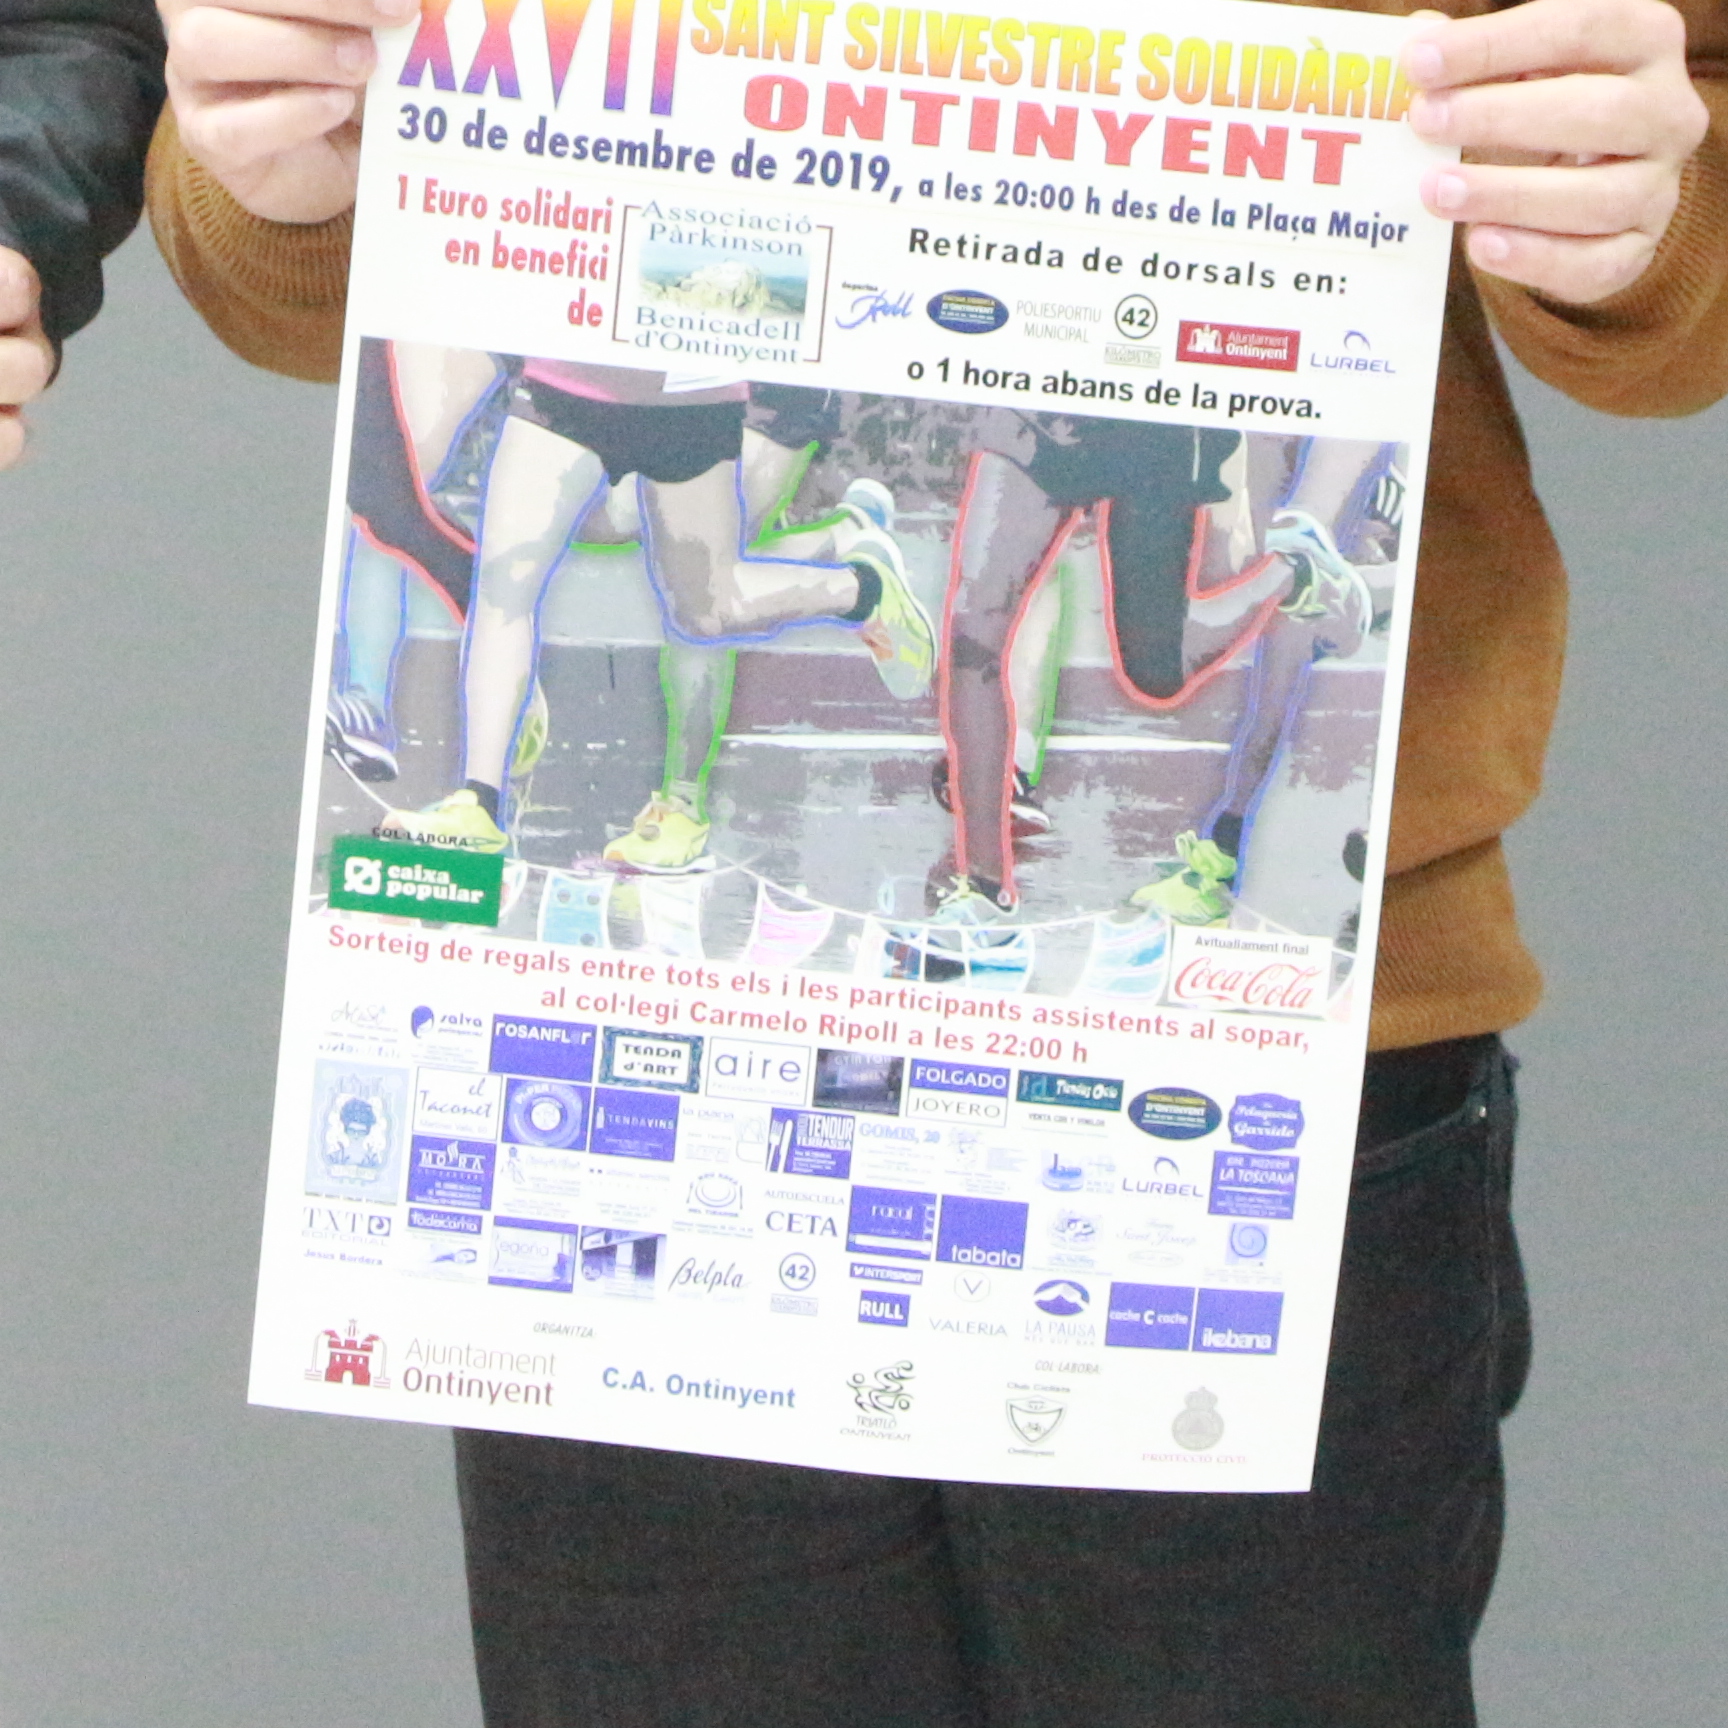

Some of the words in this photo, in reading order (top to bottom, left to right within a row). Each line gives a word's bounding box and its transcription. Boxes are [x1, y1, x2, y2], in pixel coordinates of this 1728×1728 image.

[843, 2, 1126, 96] SILVESTRE
[743, 74, 1361, 186] ONTINYENT
[397, 103, 447, 143] 30
[462, 107, 508, 151] de
[523, 115, 715, 174] desembre
[730, 137, 777, 180] de
[793, 147, 902, 203] 2019,
[918, 179, 934, 198] a
[944, 171, 982, 202] les
[993, 179, 1074, 211] 20:00
[1084, 185, 1100, 215] h
[1111, 189, 1157, 220] des
[1168, 194, 1200, 224] de
[1211, 198, 1236, 228] la
[1246, 202, 1316, 240] Plaça
[1327, 210, 1408, 248] Major
[397, 174, 408, 210] 1
[422, 177, 487, 219] Euro
[499, 187, 613, 234] solidari
[641, 200, 812, 234] Associació
[444, 238, 480, 266] en
[491, 229, 609, 281] benefici
[908, 227, 1063, 268] Retirada
[1082, 246, 1122, 274] de
[1140, 252, 1274, 288] dorsals
[1293, 272, 1346, 294] en:
[567, 287, 603, 327] de
[636, 306, 802, 341] Benicadell
[1121, 307, 1150, 327] 42
[1309, 352, 1395, 373] LURBEL
[906, 361, 924, 380] o
[937, 357, 949, 382] 1
[962, 359, 1030, 391] hora
[1041, 369, 1133, 401] abans
[1144, 379, 1181, 406] de
[1191, 382, 1217, 409] la
[1227, 393, 1320, 418] prova.
[385, 874, 484, 903] popular
[386, 863, 453, 884] caixa
[328, 924, 429, 963] Sorteig
[440, 938, 472, 962] de
[483, 949, 569, 975] regals
[581, 959, 654, 982] entre
[666, 964, 719, 989] tots
[730, 971, 770, 994] els
[781, 974, 787, 996] i
[799, 976, 838, 1001] les
[849, 987, 1021, 1021] participants
[1032, 1006, 1178, 1036] assistents
[1190, 1018, 1214, 1039] al
[1225, 1025, 1308, 1052] sopar,
[540, 986, 565, 1008] al
[689, 1000, 807, 1033] Carmelo
[818, 1013, 897, 1044] Ripoll
[908, 1029, 923, 1045] a
[934, 1026, 973, 1051] les
[985, 1032, 1061, 1060] 22:00
[1072, 1040, 1087, 1063] h
[405, 1337, 555, 1376] Ajuntament
[402, 1366, 552, 1406] Ontinyent
[602, 1366, 654, 1392] C.A.
[665, 1373, 795, 1408] Ontinyent
